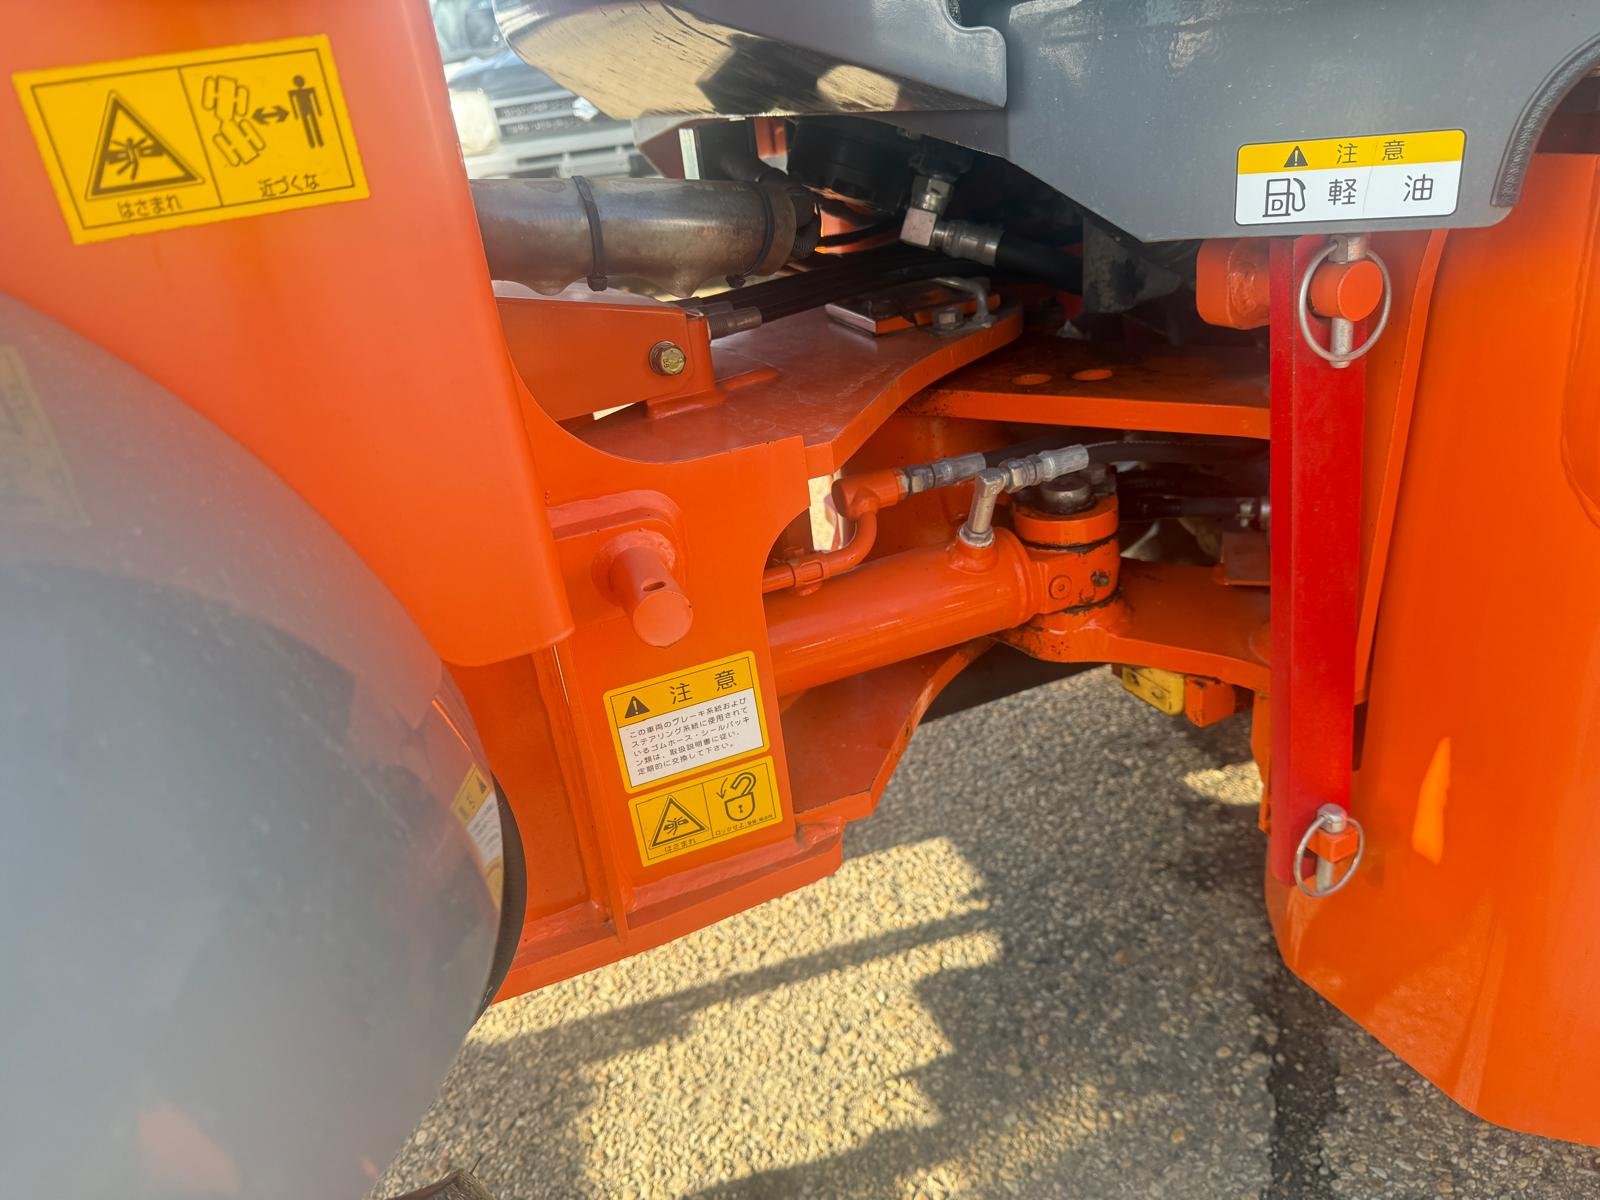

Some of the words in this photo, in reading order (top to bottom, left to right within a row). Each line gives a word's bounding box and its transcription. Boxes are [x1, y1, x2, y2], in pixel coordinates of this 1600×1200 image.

[258, 174, 320, 198] 近づくな
[117, 194, 183, 220] はさまれ
[664, 837, 696, 853] はさまれ
